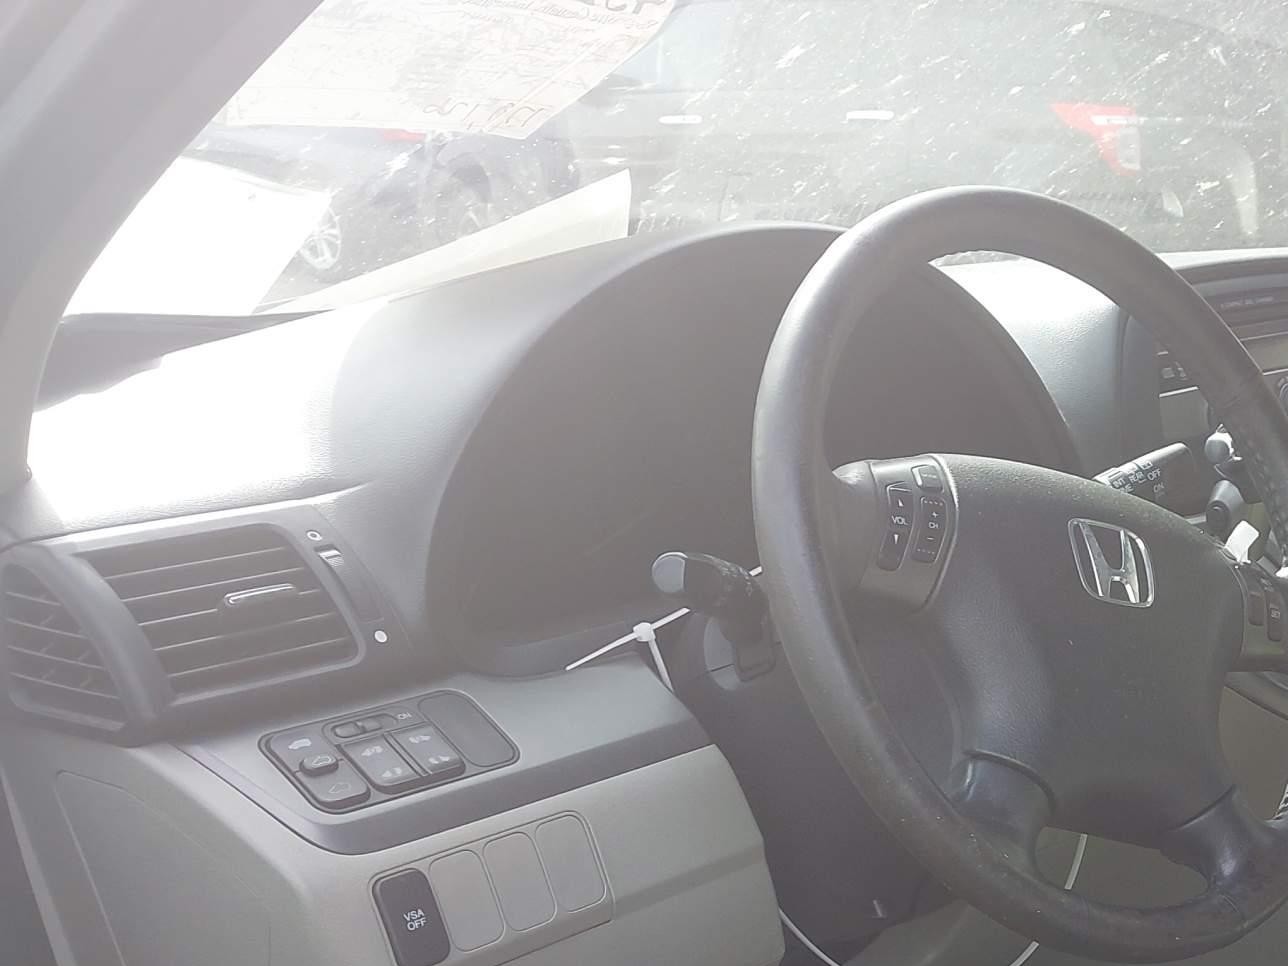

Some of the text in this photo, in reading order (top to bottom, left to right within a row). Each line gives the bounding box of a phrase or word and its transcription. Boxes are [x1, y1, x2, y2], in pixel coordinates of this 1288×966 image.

[1147, 468, 1161, 481] OFF
[1153, 482, 1164, 493] ON
[891, 515, 908, 525] VOL
[403, 909, 424, 921] VSA
[407, 917, 426, 930] OFF
